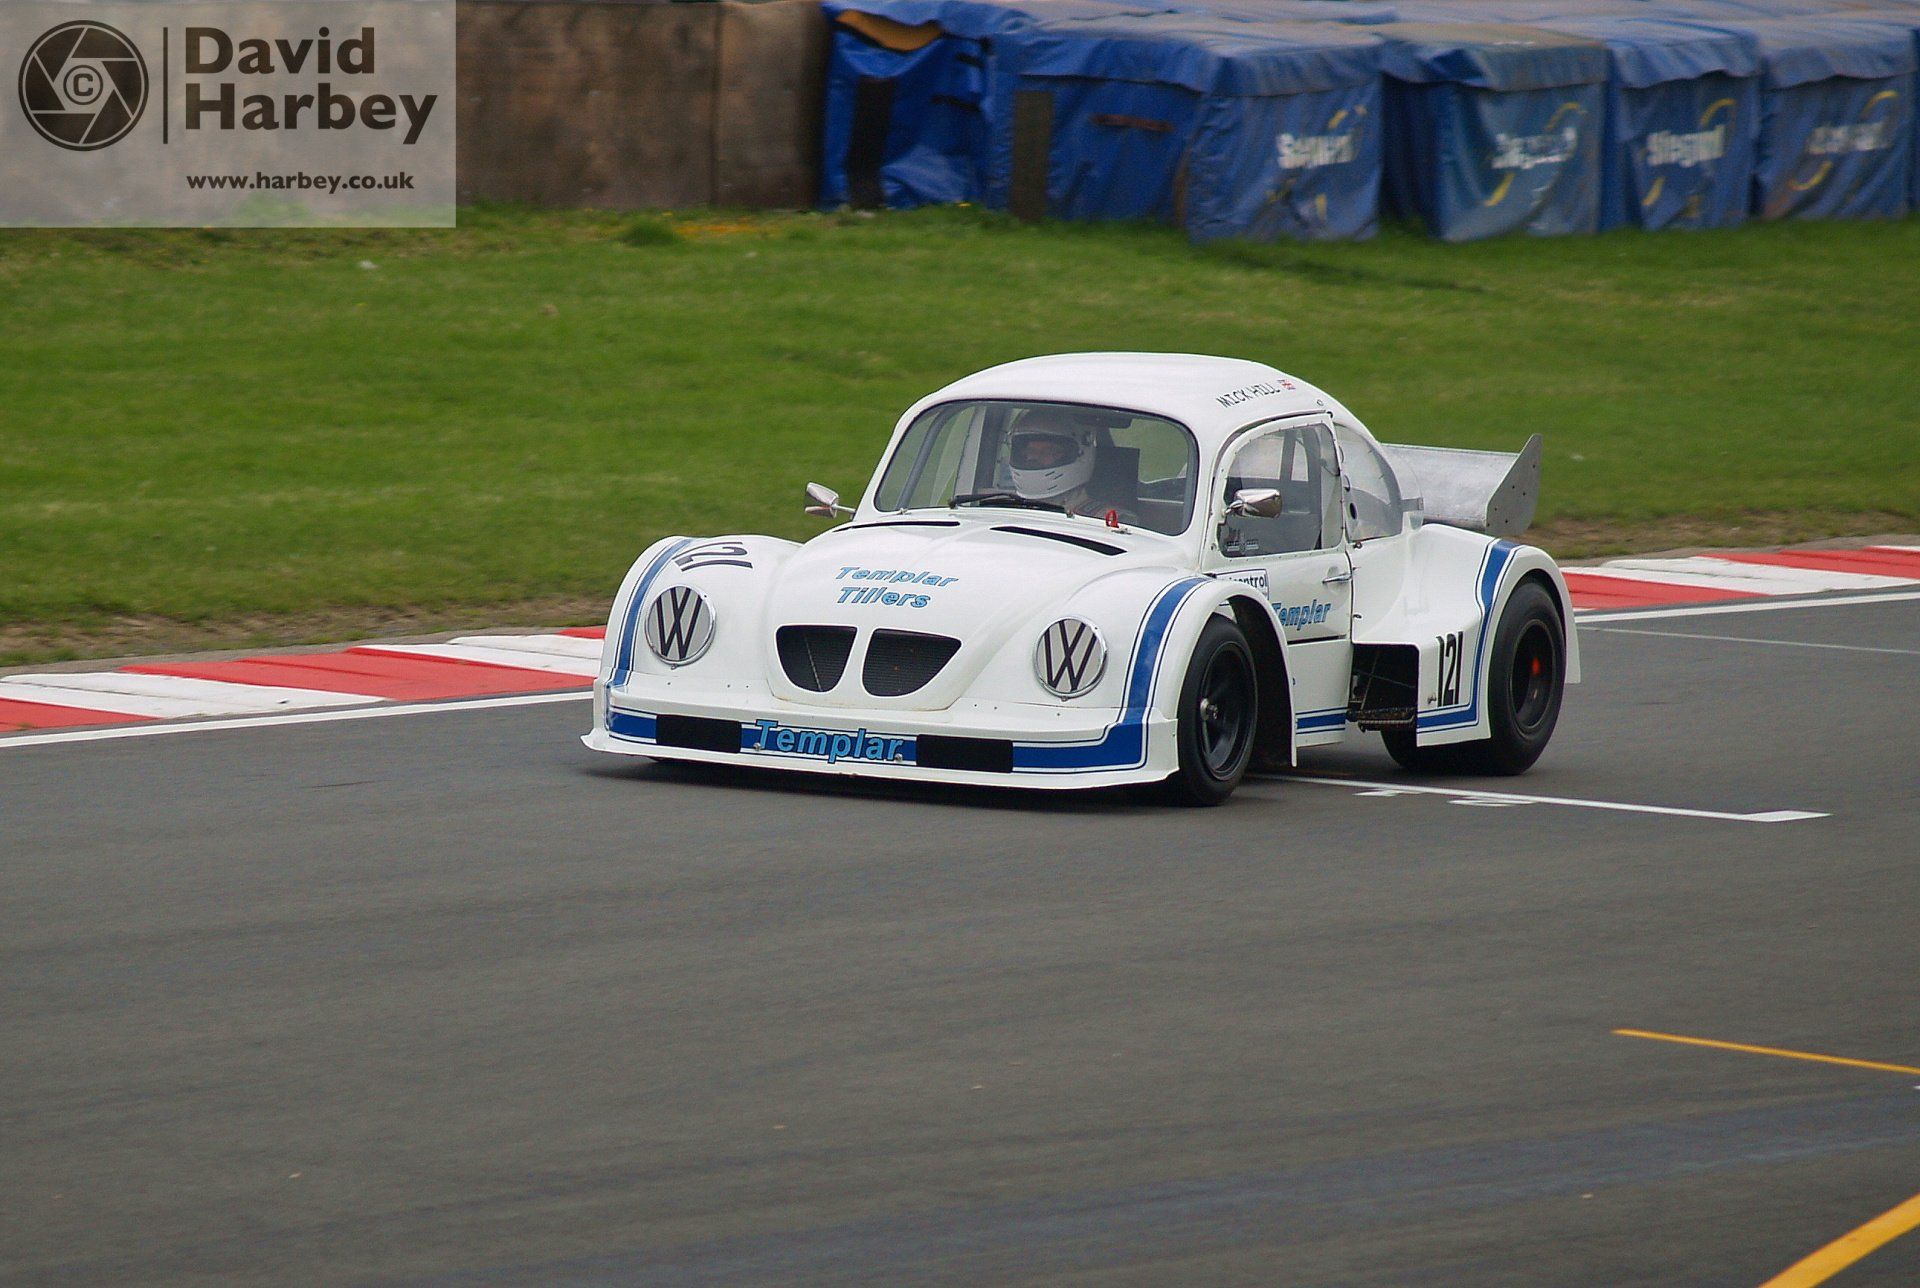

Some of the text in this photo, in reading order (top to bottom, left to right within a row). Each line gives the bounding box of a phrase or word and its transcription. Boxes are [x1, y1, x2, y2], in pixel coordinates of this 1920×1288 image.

[1215, 382, 1281, 408] MICK HILL
[671, 541, 754, 573] 121
[835, 566, 959, 587] Templar
[836, 586, 931, 608] Tillers
[1435, 630, 1464, 708] 121
[755, 718, 904, 764] Templar
